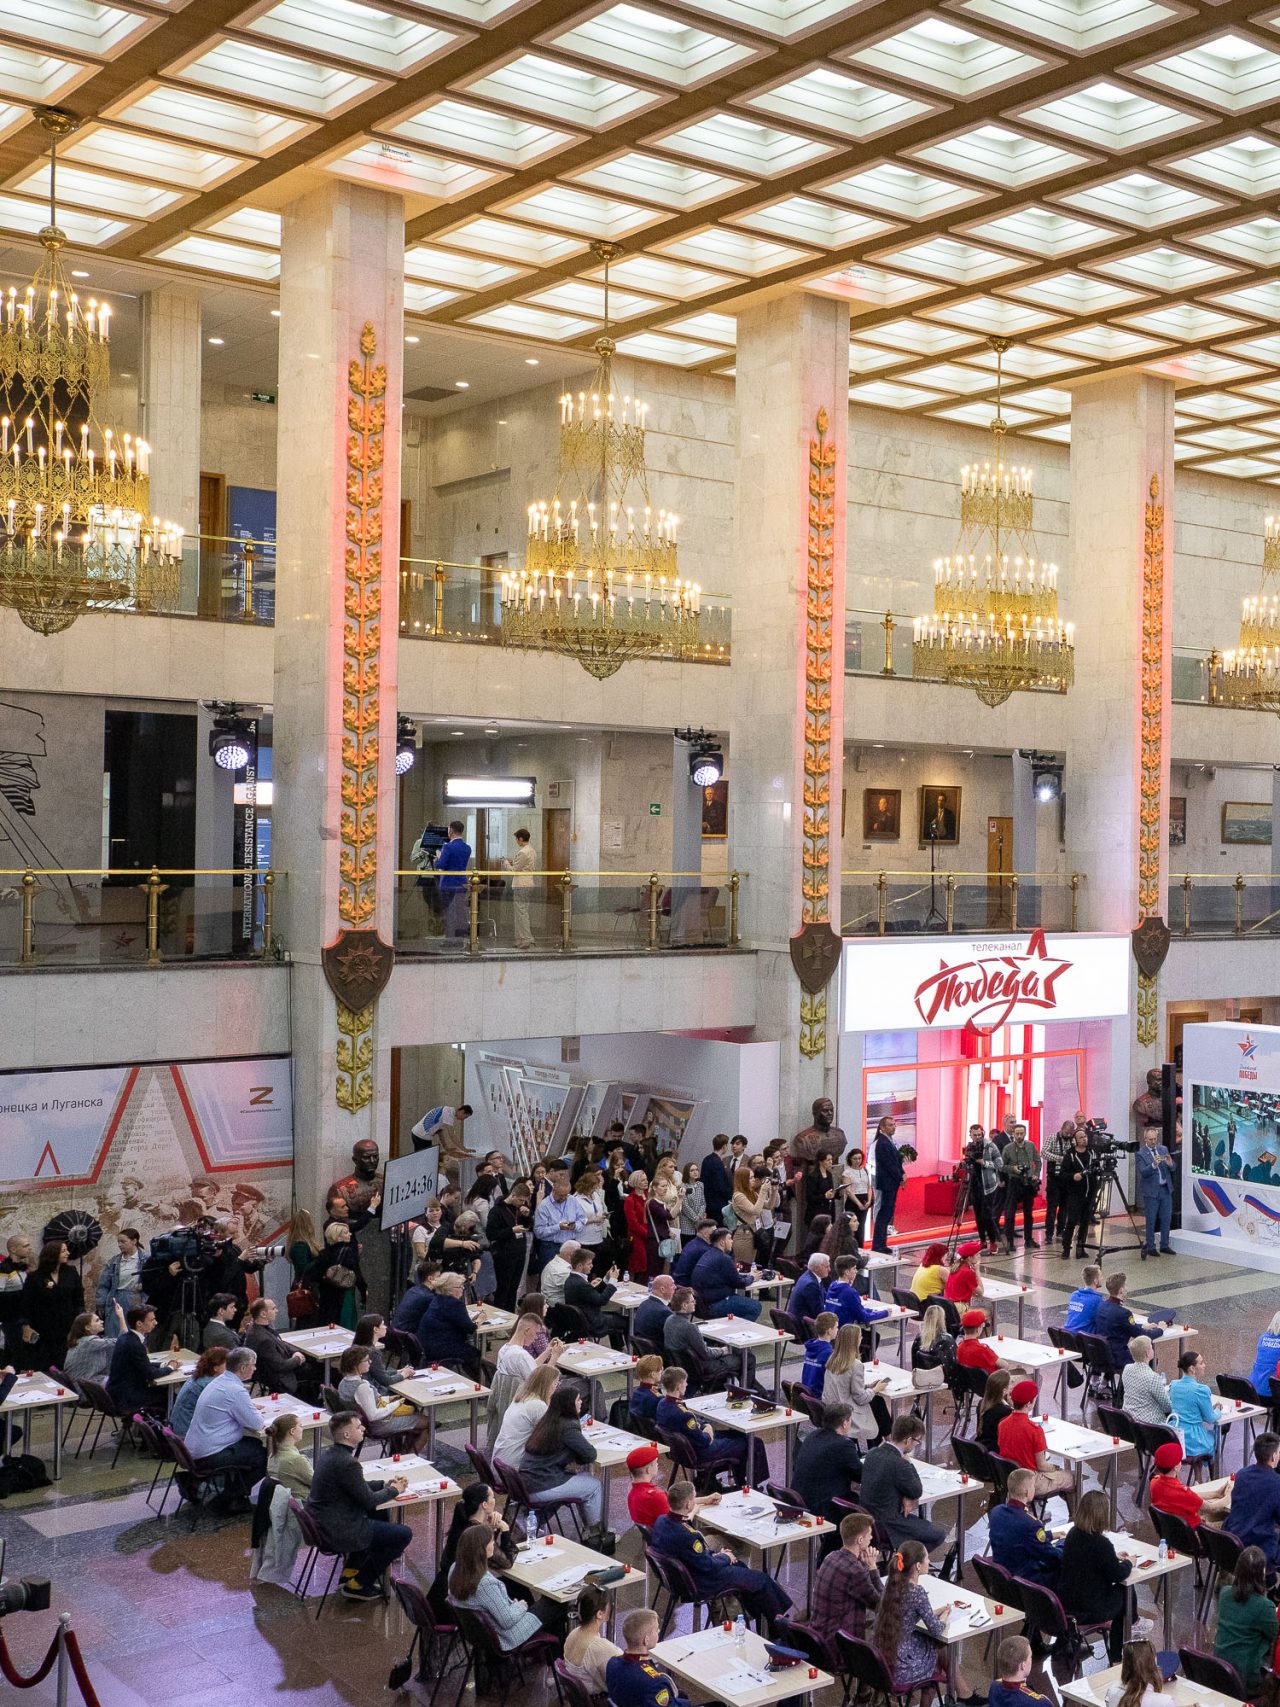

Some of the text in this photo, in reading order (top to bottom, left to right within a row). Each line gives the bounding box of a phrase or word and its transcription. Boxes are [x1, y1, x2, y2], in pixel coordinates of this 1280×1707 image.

[244, 807, 254, 864] RESISTANCE
[971, 942, 1023, 952] телеканал
[42, 1102, 48, 1110] и
[51, 1098, 103, 1112] Луганска
[389, 1173, 433, 1206] 11:24:36
